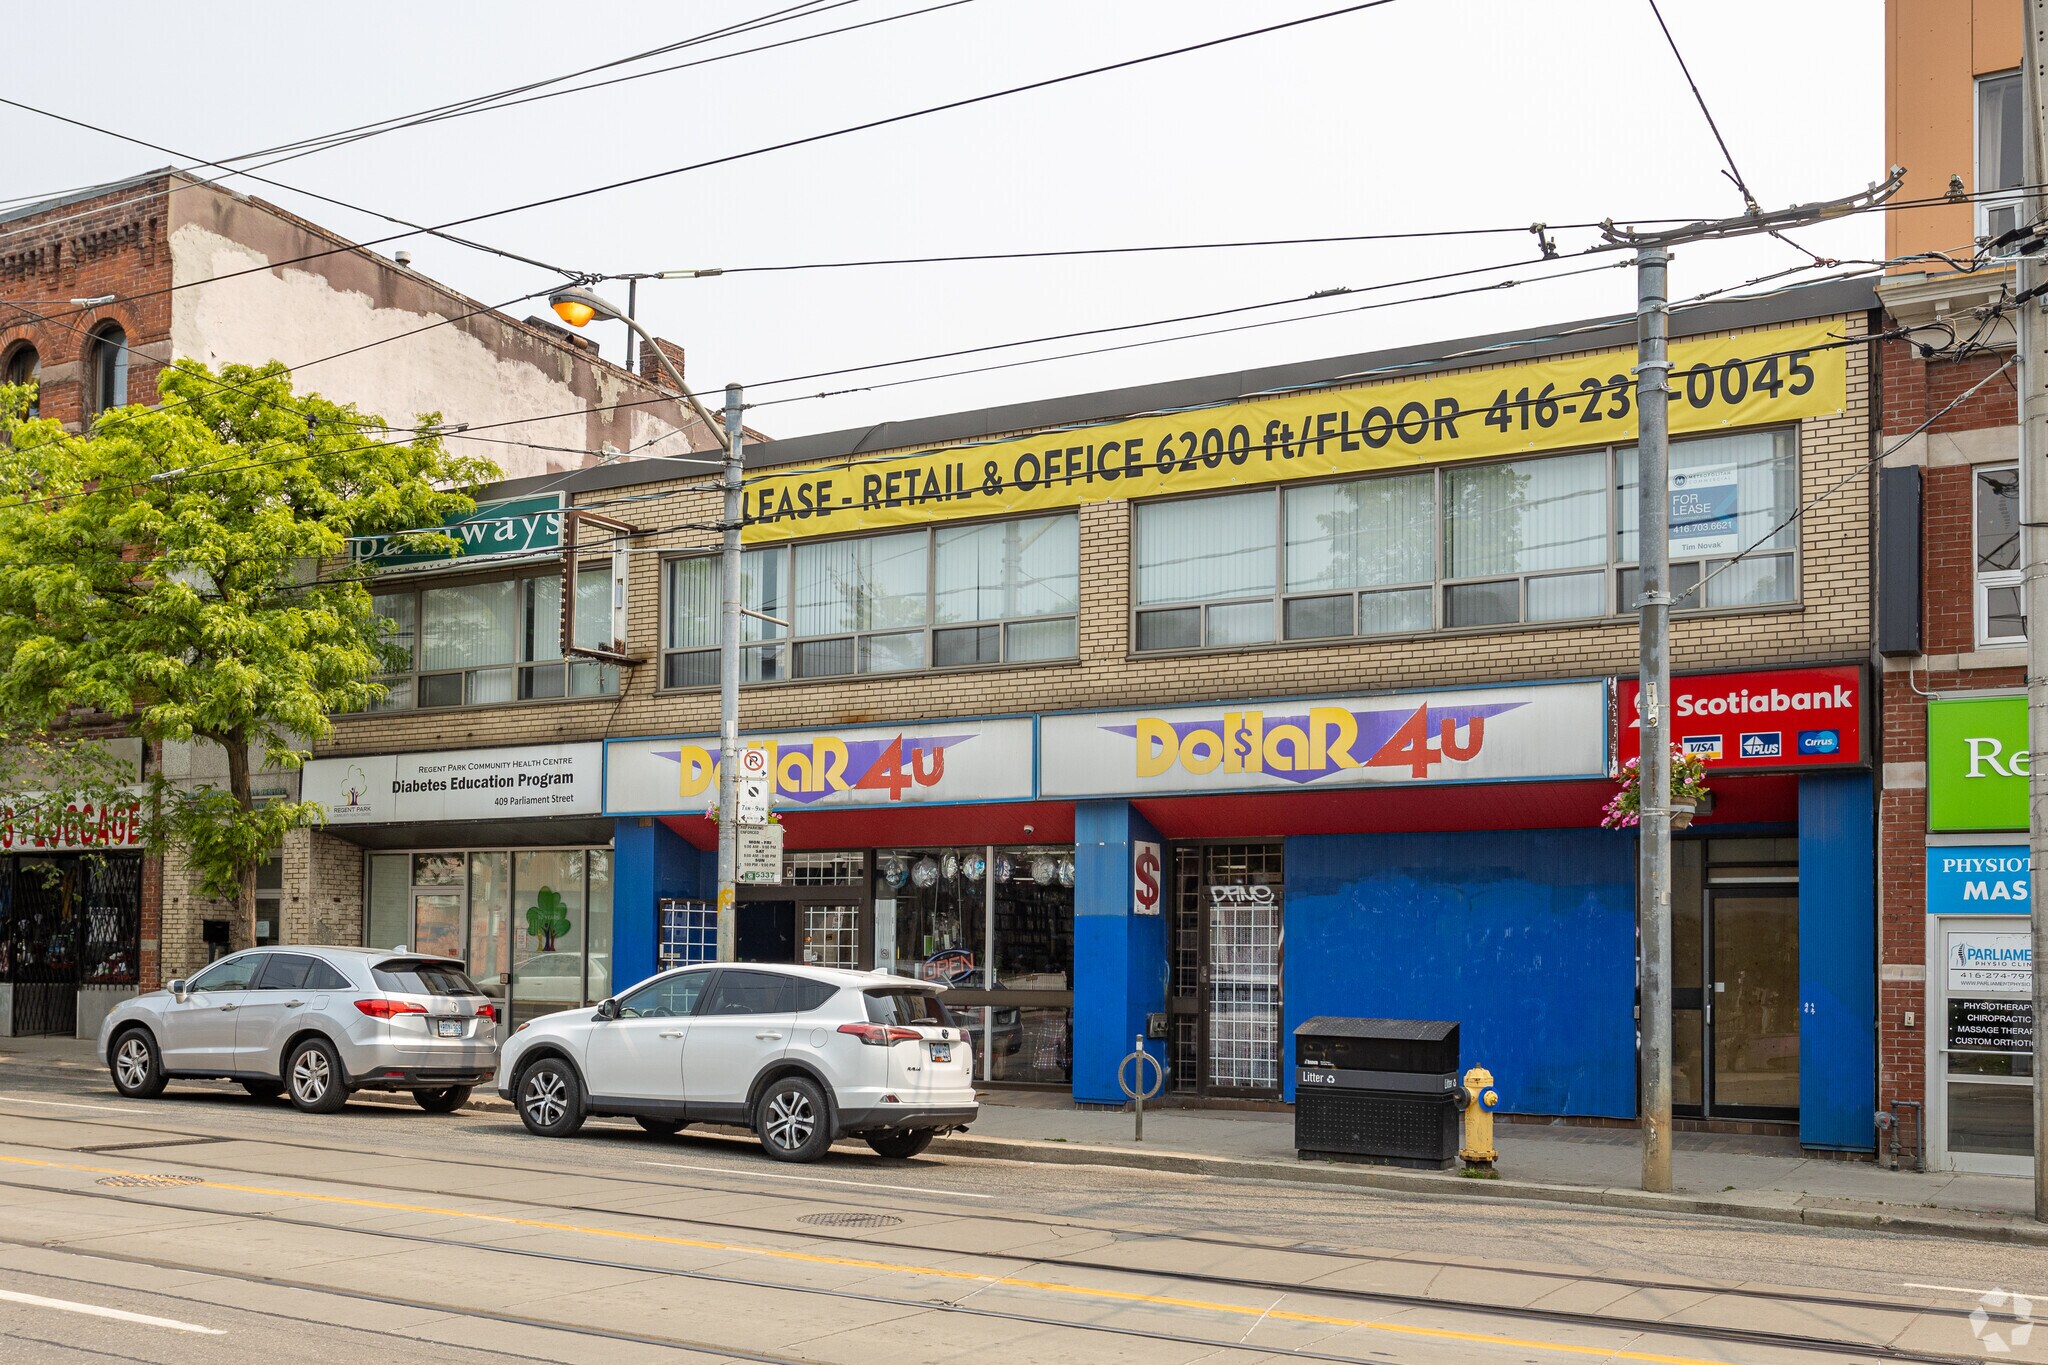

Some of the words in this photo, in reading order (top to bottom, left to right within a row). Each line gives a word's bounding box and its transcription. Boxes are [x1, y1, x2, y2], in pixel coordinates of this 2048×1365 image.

[744, 479, 833, 525] LEASE
[863, 462, 971, 511] RETAIL
[982, 460, 1004, 496] &
[1014, 438, 1144, 492] OFFICE
[1156, 424, 1251, 475] 6200
[1262, 397, 1460, 461] ft/FLOOR
[1484, 351, 1815, 433] 416-23-0045
[1673, 493, 1698, 505] FOR
[1673, 502, 1711, 516] LEASE
[1673, 521, 1733, 534] 416.703.6621
[1682, 543, 1696, 551] Tim
[1676, 684, 1853, 717] Scotiabank
[1689, 742, 1715, 753] VISA
[1754, 742, 1779, 755] PLUS
[418, 765, 447, 774] REGENT
[447, 763, 467, 772] PARK
[467, 761, 511, 771] COMMUNITY
[512, 759, 541, 768] HEALTH
[542, 757, 573, 767] CENTRE
[392, 778, 447, 794] Diabetes
[450, 774, 514, 790] Education
[518, 772, 574, 789] Program
[494, 797, 509, 806] 409
[510, 795, 550, 806] Parliament
[551, 794, 574, 804] Street
[333, 806, 356, 814] REGENT
[1963, 880, 2030, 901] MAS
[923, 952, 975, 981] OPEN
[1967, 1014, 2032, 1023] CHIROPRACTIC
[1957, 1025, 1999, 1034] MASSAGE
[1955, 1037, 1992, 1046] CUSTOM
[1302, 1071, 1324, 1083] Litter
